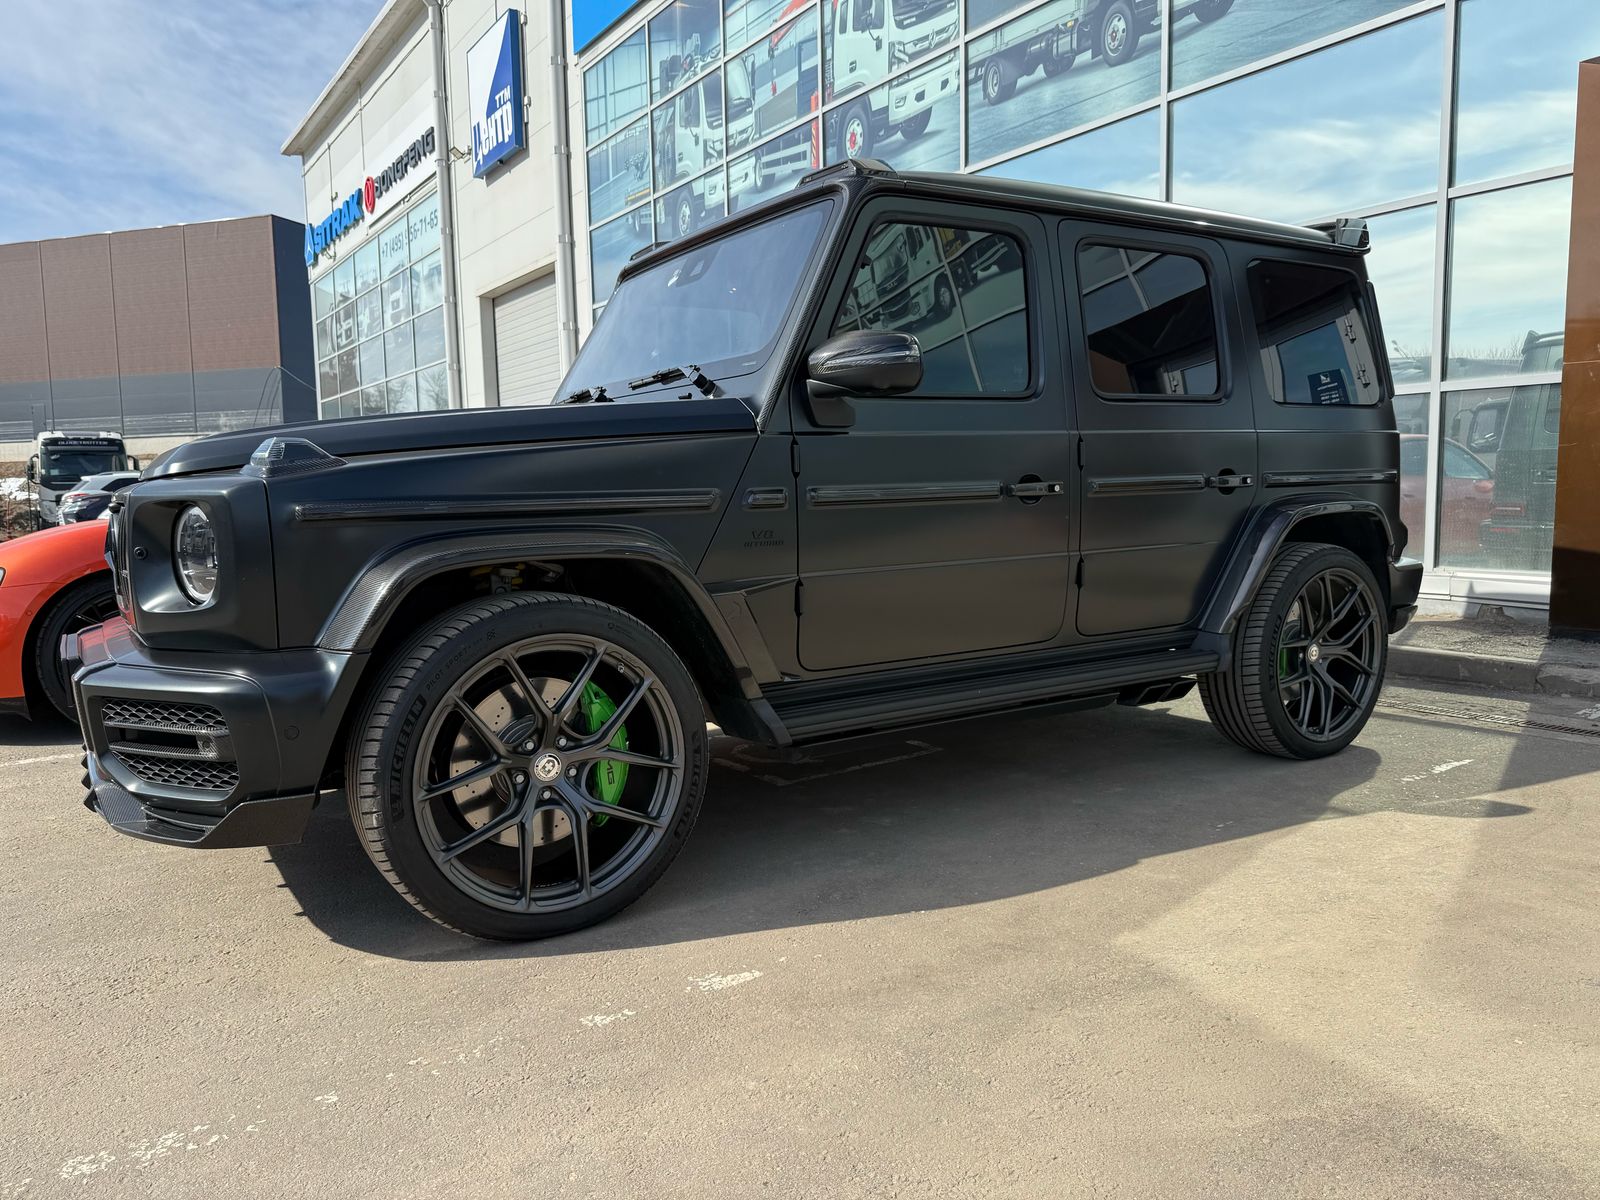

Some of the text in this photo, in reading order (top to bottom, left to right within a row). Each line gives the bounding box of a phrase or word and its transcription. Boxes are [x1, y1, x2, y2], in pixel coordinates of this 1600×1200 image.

[495, 85, 511, 109] ТТМ
[374, 126, 436, 199] DONGFENG
[472, 100, 513, 174] Центр
[314, 188, 364, 255] SITRAK
[391, 695, 426, 800] MICHELIN
